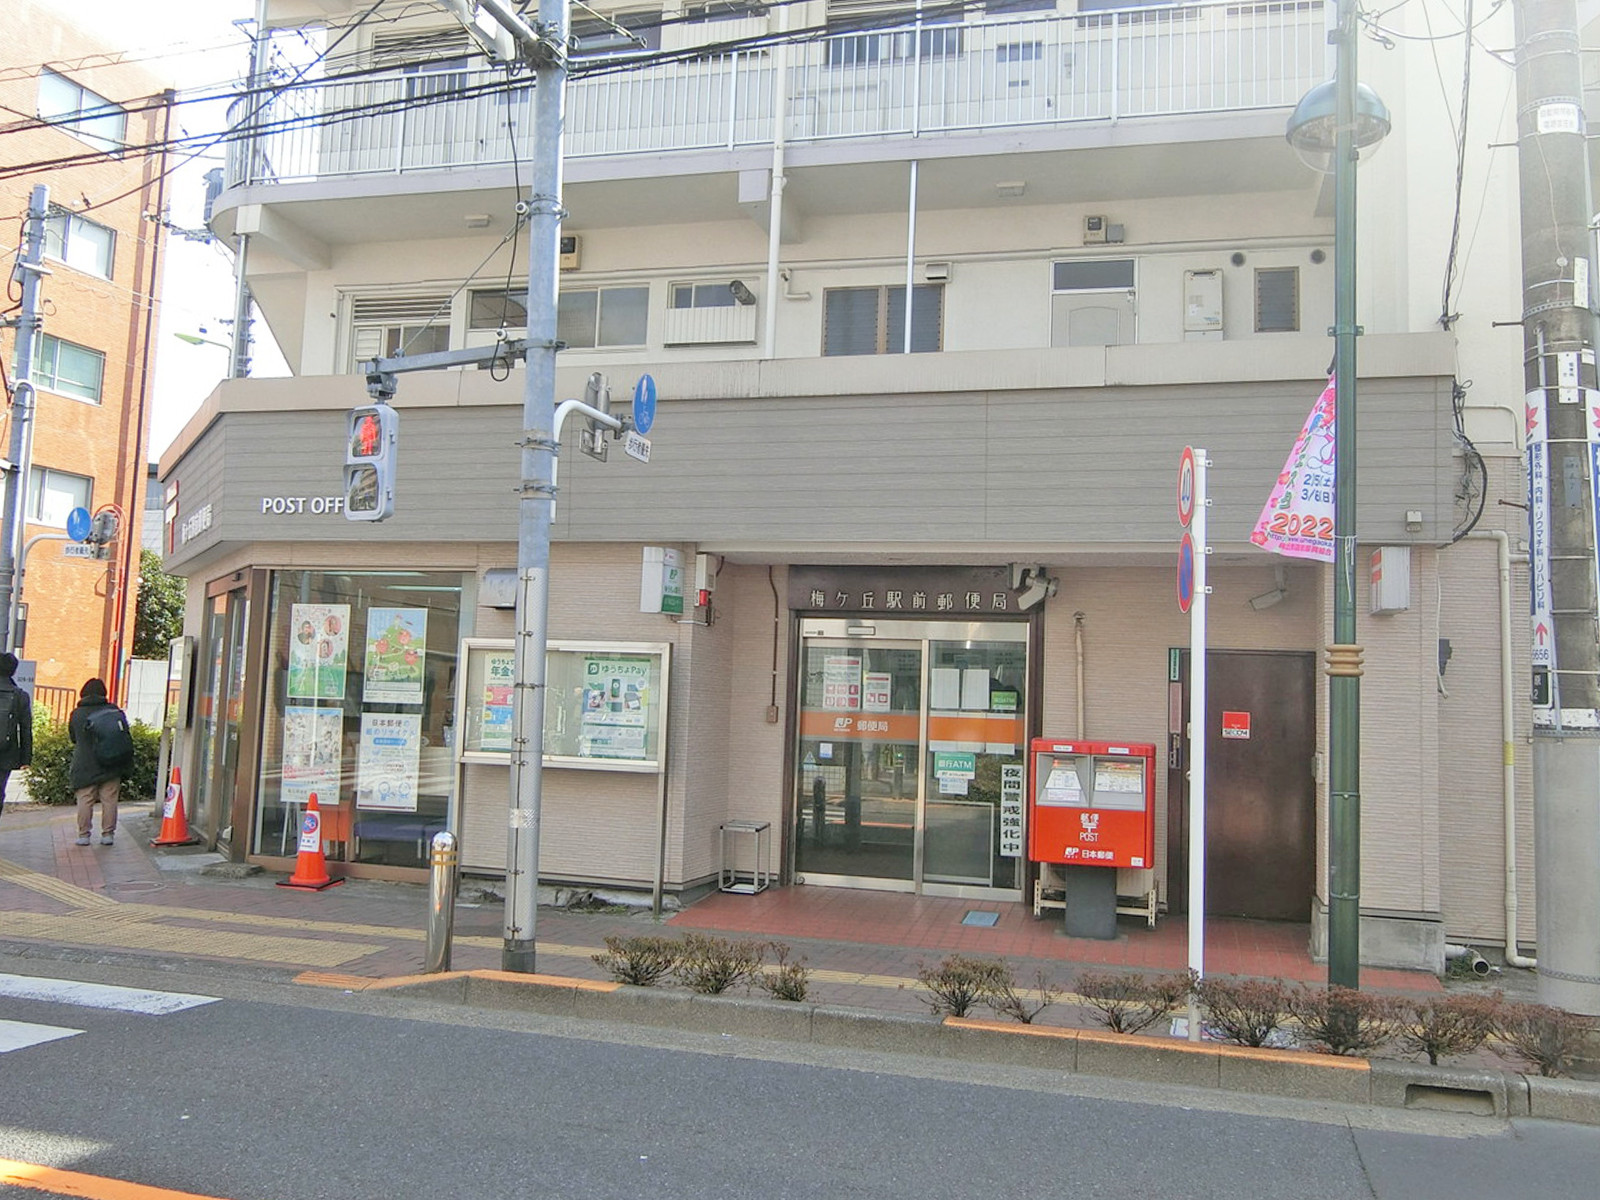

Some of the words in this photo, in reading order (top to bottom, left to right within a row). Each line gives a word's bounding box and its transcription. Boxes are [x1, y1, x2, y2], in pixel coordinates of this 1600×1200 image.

[262, 497, 306, 514] POST
[1270, 512, 1334, 540] 2022
[601, 665, 647, 676] ゆうちょPay
[1080, 832, 1099, 842] POST
[1082, 849, 1114, 860] 日本郵便
